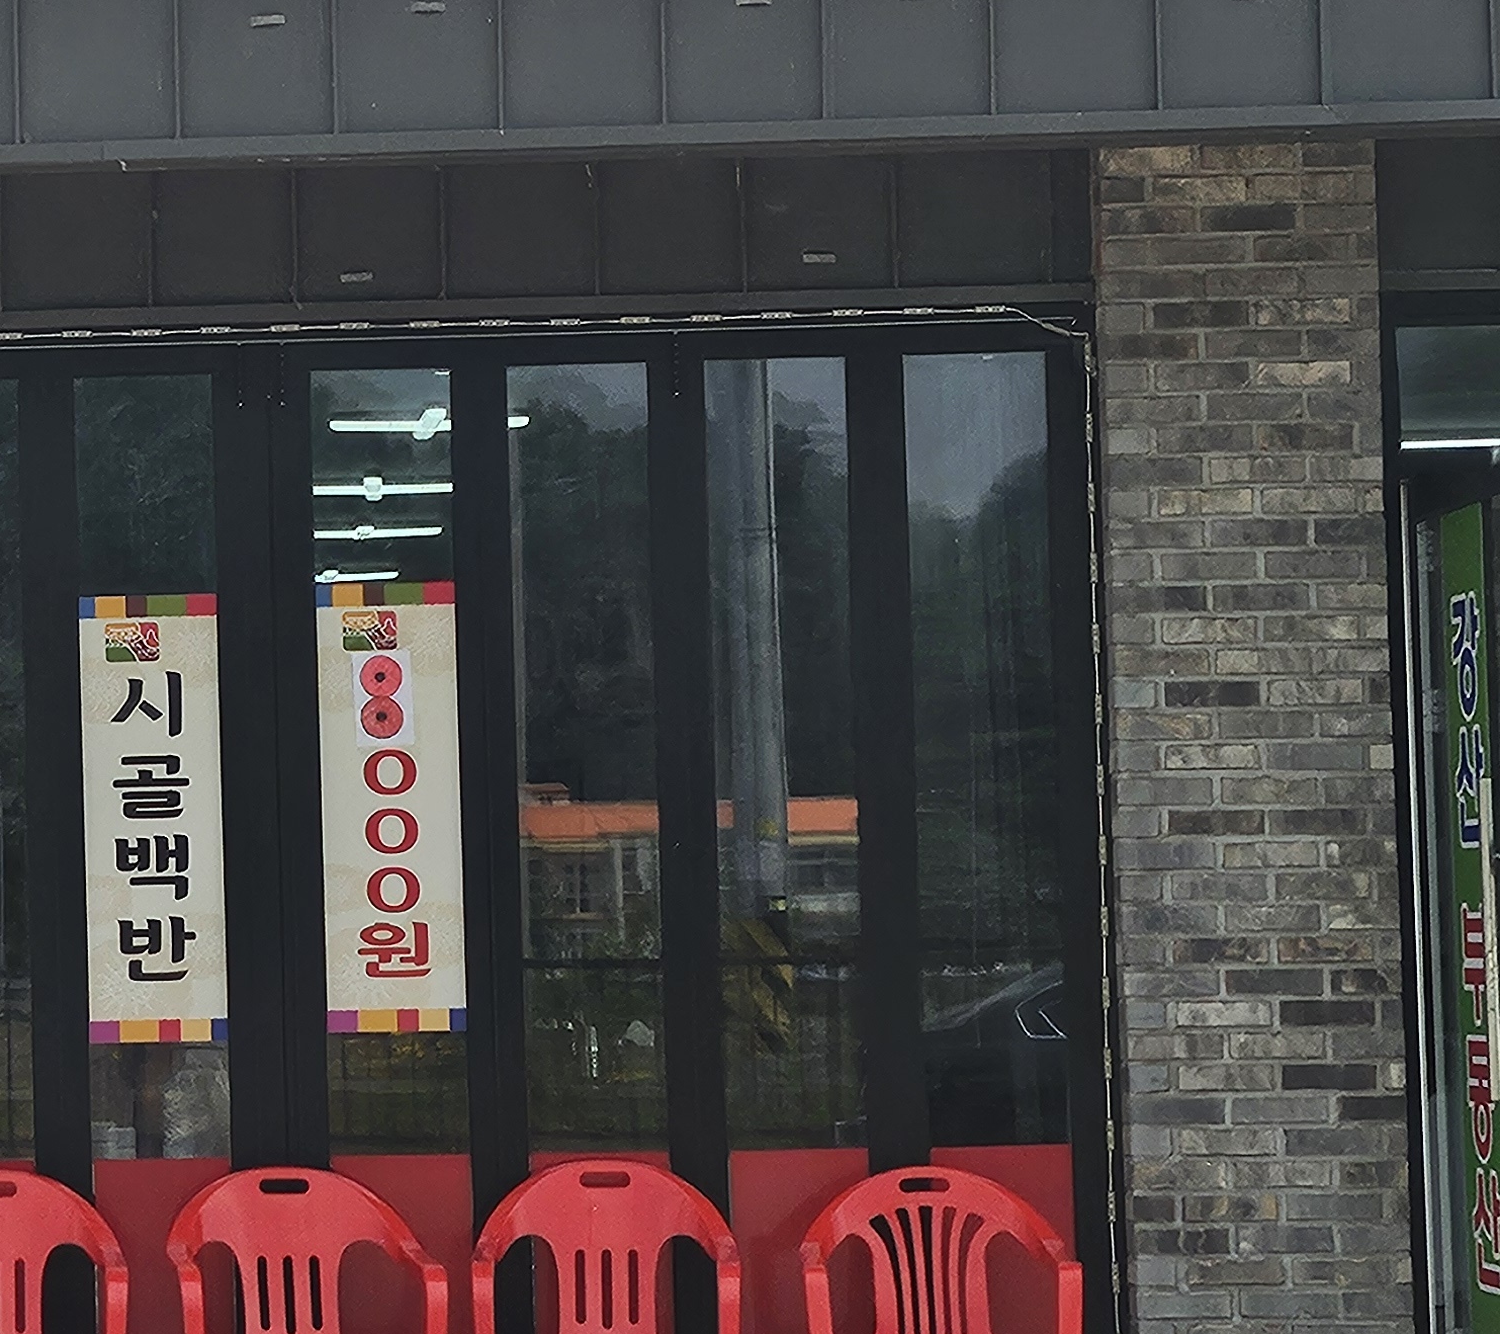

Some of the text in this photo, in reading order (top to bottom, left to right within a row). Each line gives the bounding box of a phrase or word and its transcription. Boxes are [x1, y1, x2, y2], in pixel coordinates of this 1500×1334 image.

[110, 670, 197, 983] 시골백반
[358, 654, 432, 979] 8000원
[1451, 591, 1484, 849] 강산
